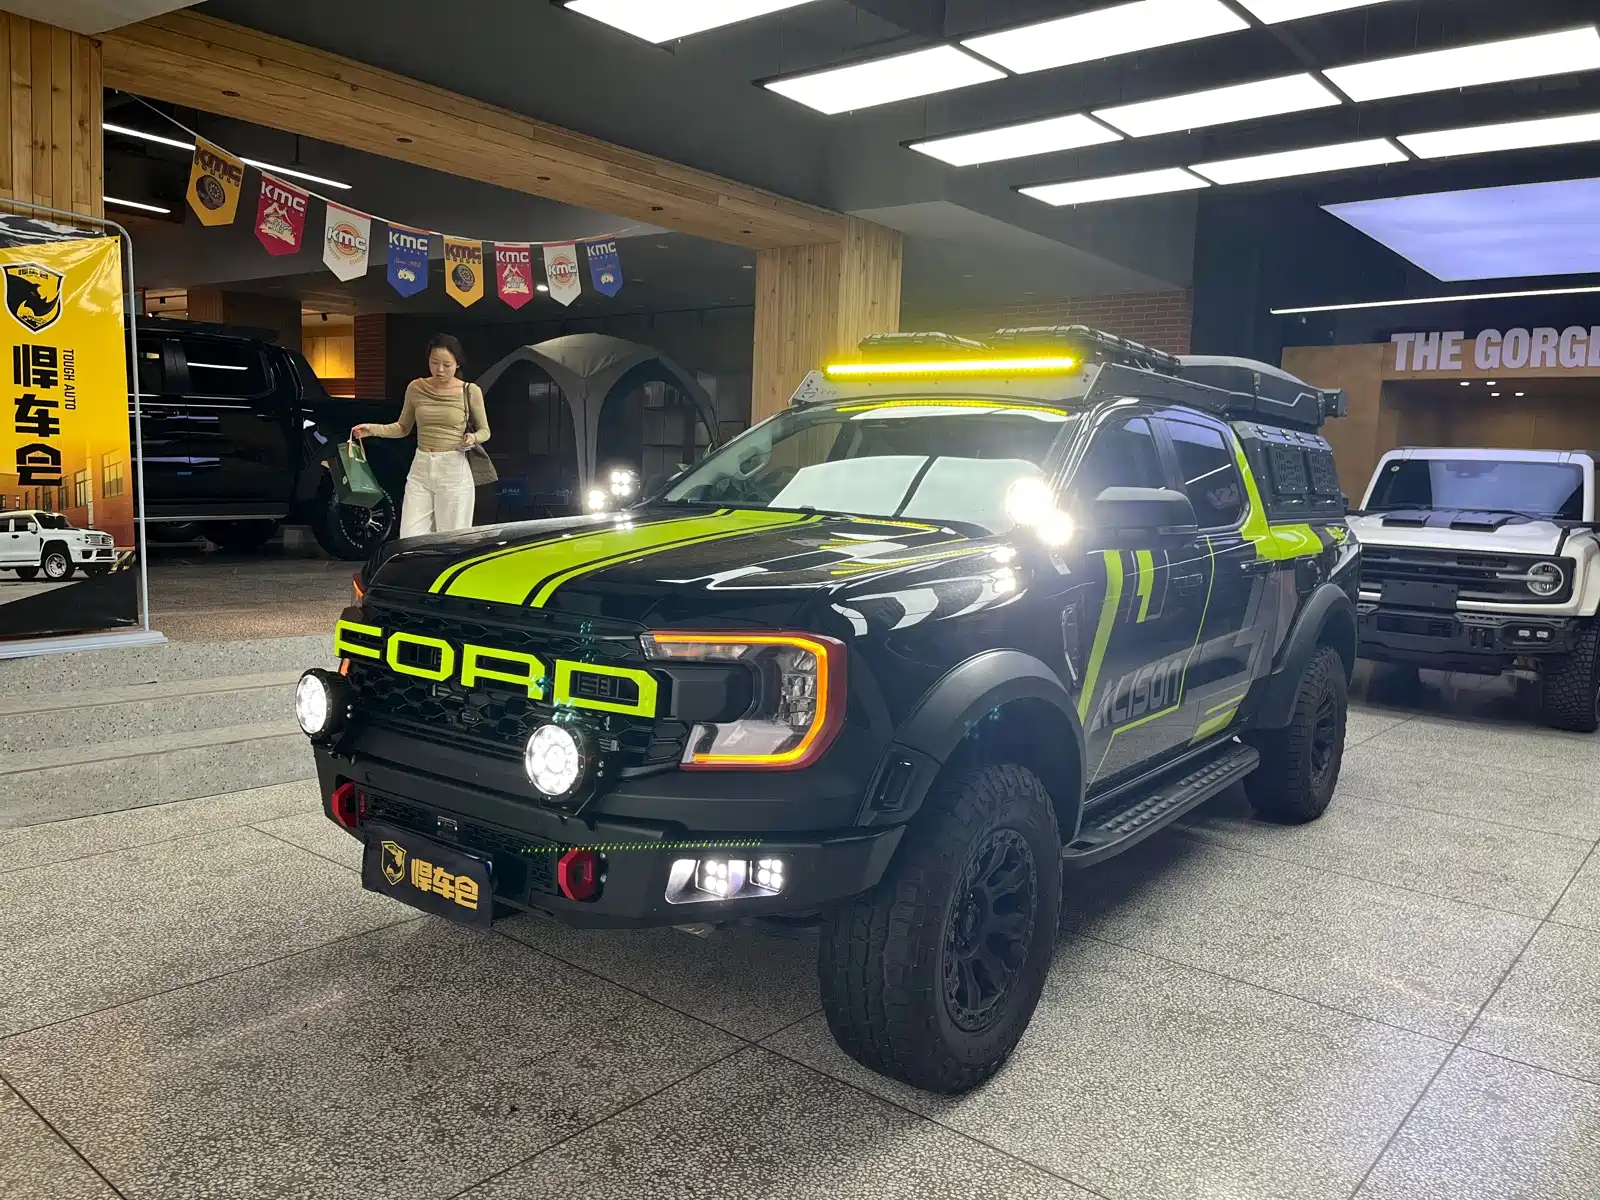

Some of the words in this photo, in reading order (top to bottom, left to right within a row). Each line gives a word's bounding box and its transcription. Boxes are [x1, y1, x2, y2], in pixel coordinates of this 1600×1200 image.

[62, 349, 75, 381] TOUGH
[1390, 331, 1464, 371] THE
[12, 344, 63, 486] 悍车会
[63, 384, 76, 410] AUTO
[334, 620, 658, 718] FORD
[411, 858, 479, 910] 悍车会
